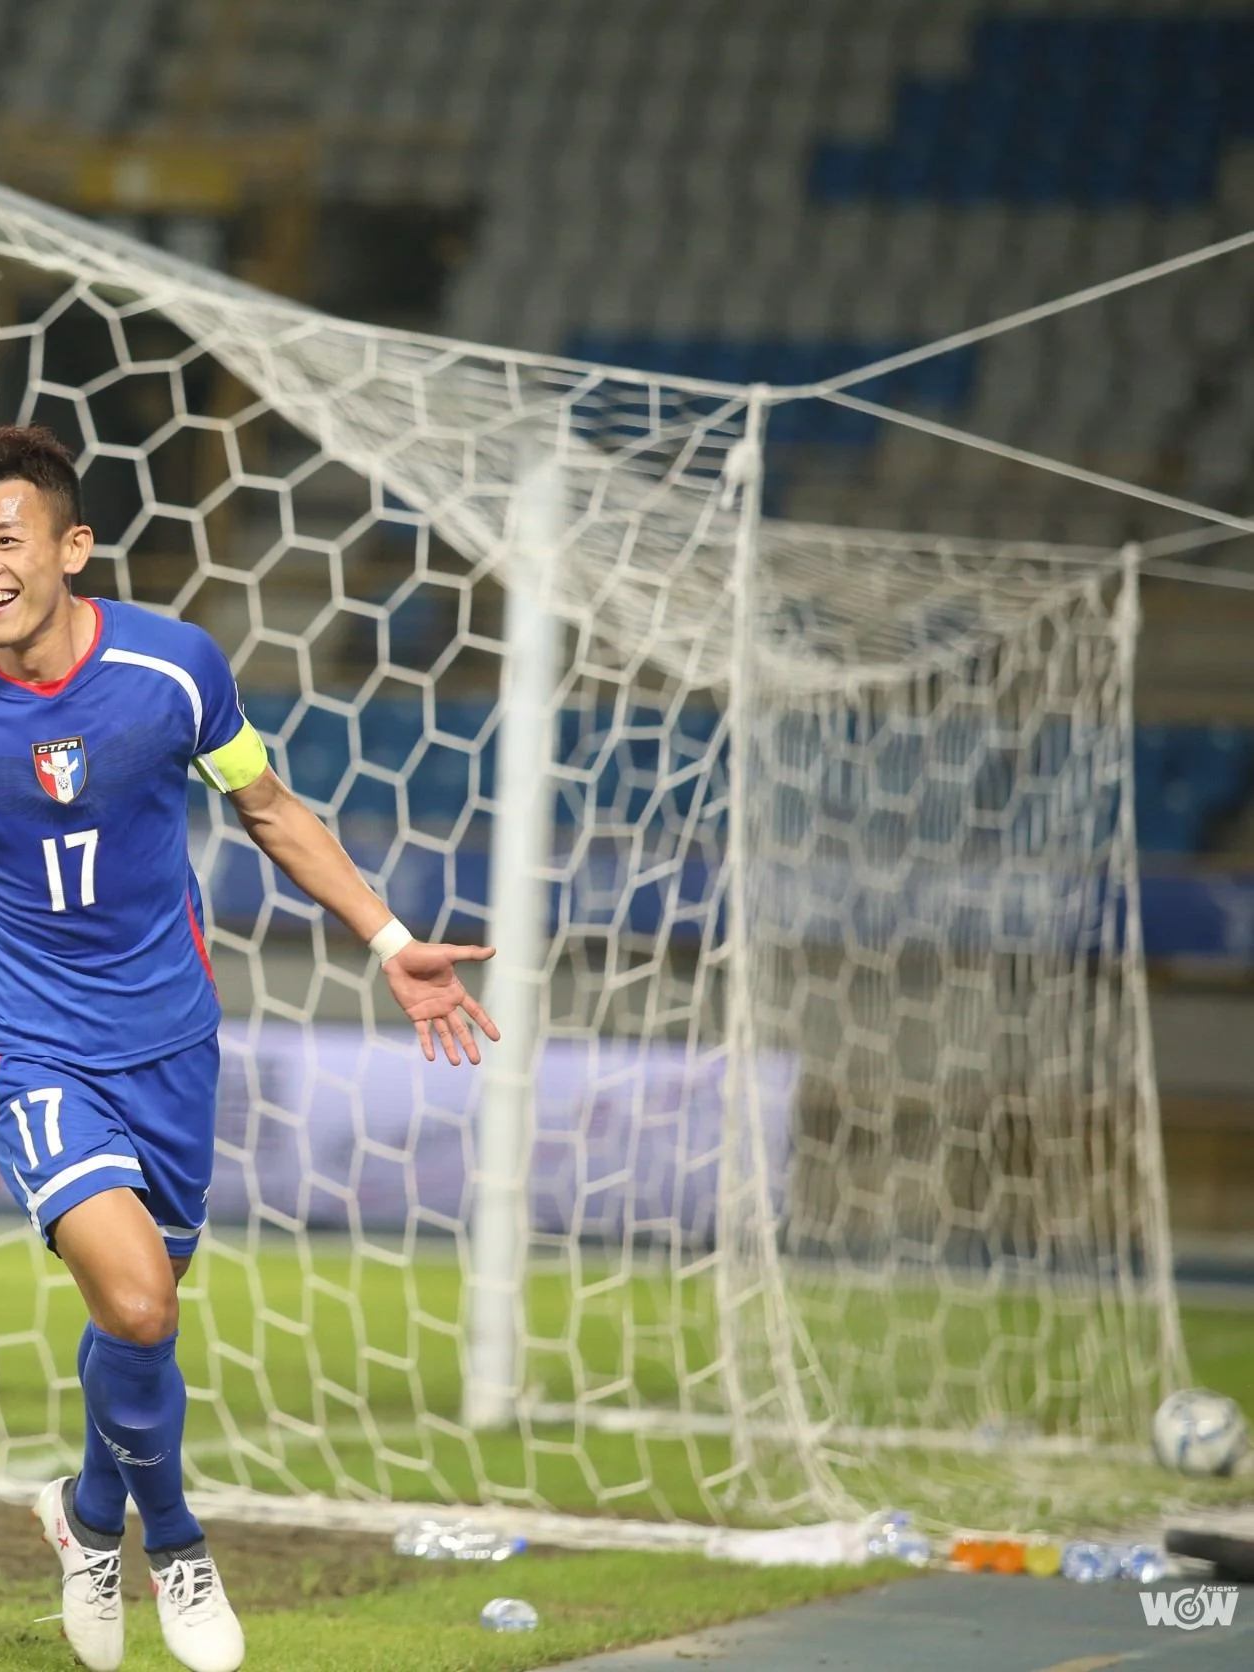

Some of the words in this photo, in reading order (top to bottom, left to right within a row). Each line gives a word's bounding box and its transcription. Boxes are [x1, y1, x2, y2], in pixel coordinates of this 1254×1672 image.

[37, 741, 78, 753] CTFA
[42, 829, 98, 912] 17
[10, 1087, 64, 1170] 17
